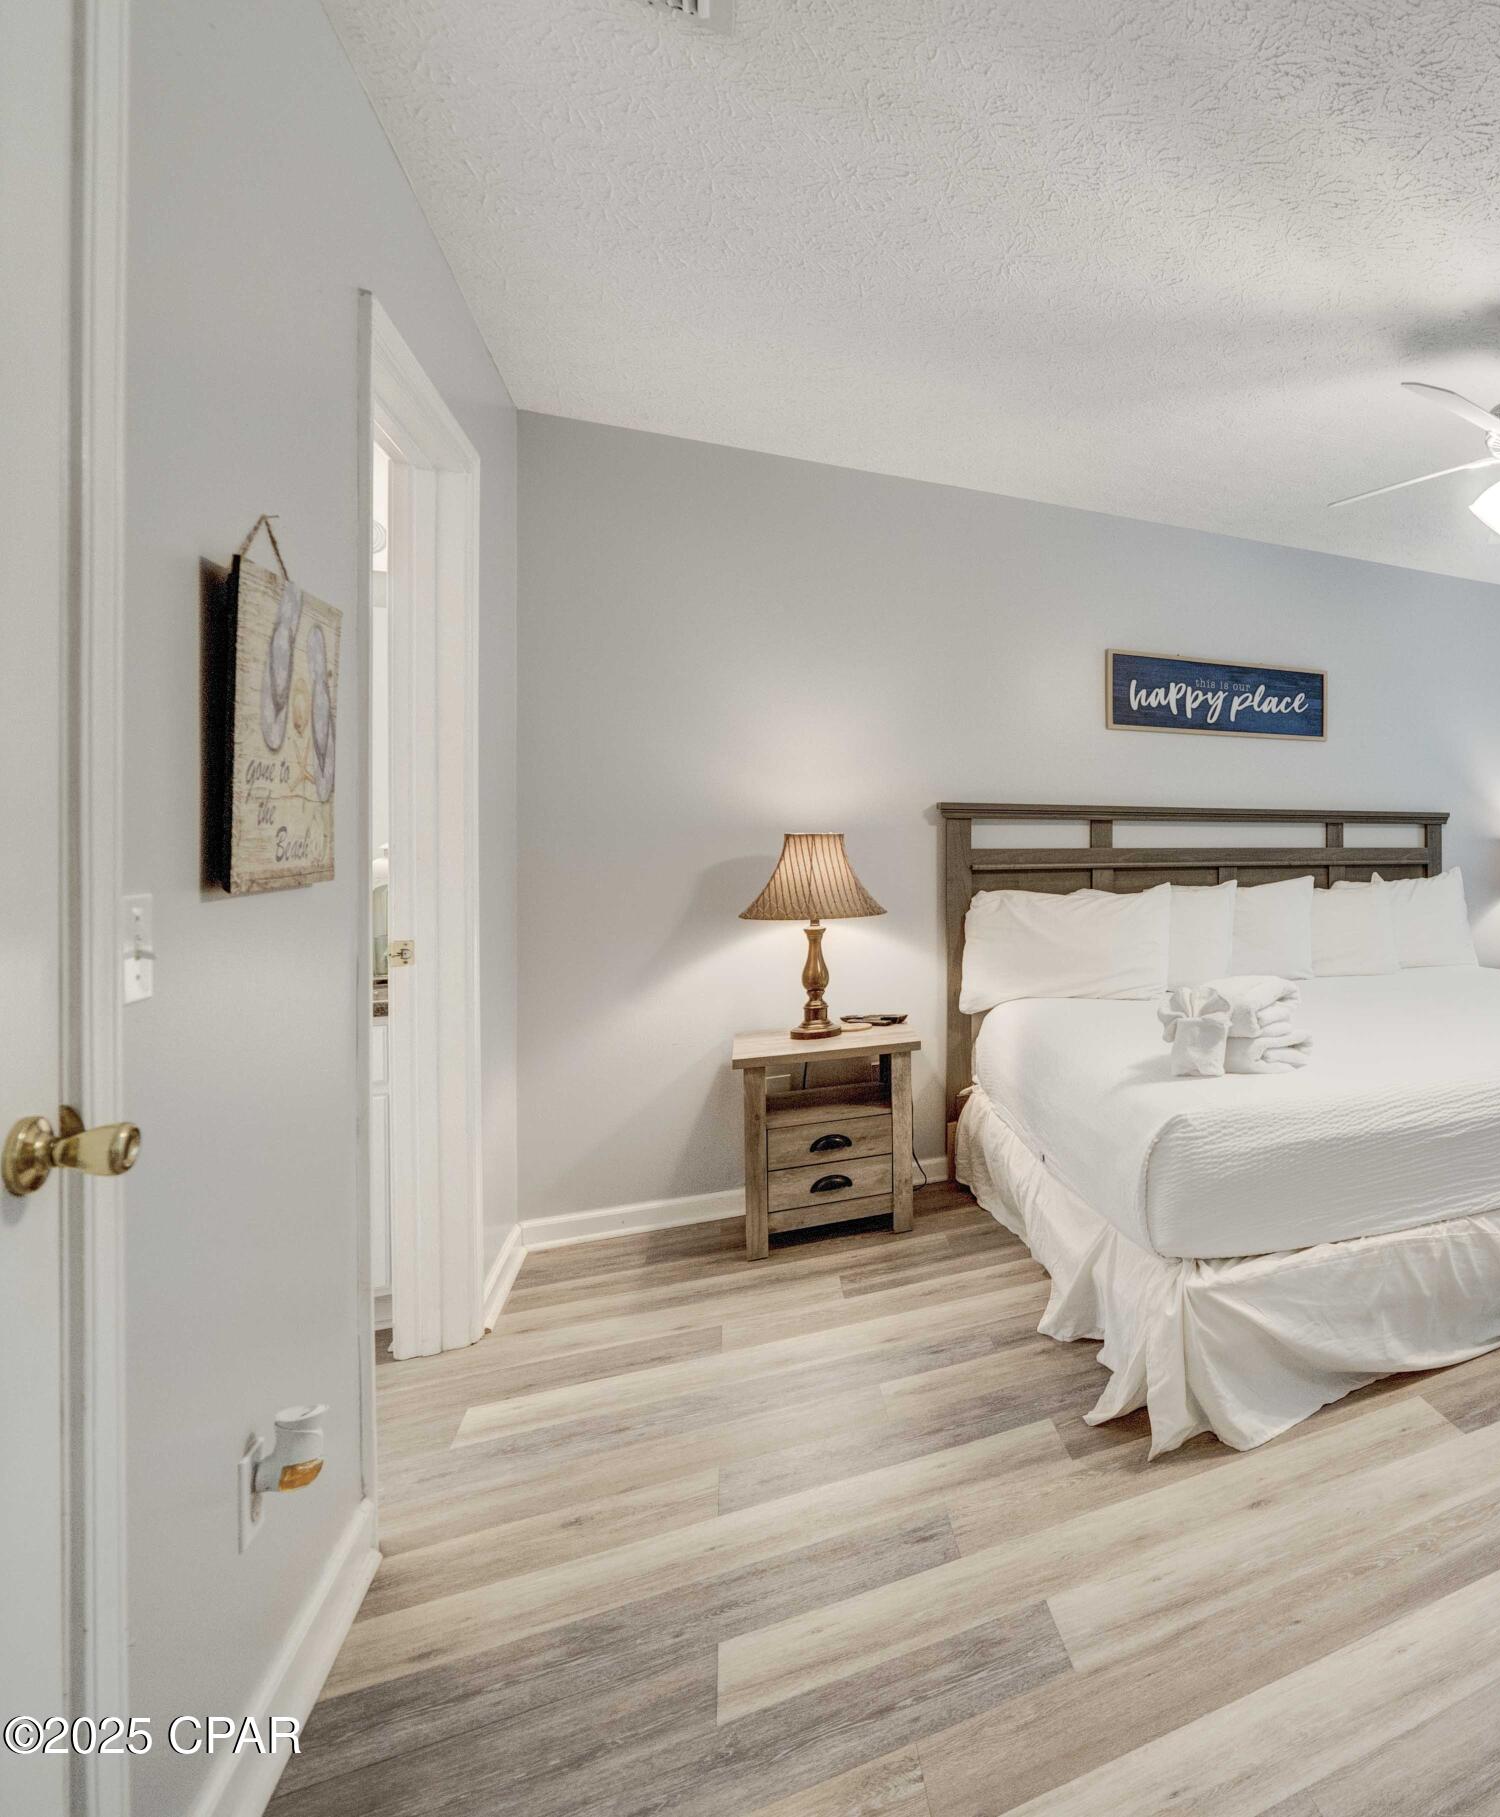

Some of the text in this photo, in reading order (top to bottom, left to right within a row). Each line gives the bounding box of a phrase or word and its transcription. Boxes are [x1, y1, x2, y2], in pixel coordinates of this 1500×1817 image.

[1129, 679, 1309, 724] happy place
[1195, 678, 1251, 692] this is our
[245, 759, 290, 805] gone to
[257, 788, 277, 827] the
[275, 825, 311, 862] Beach
